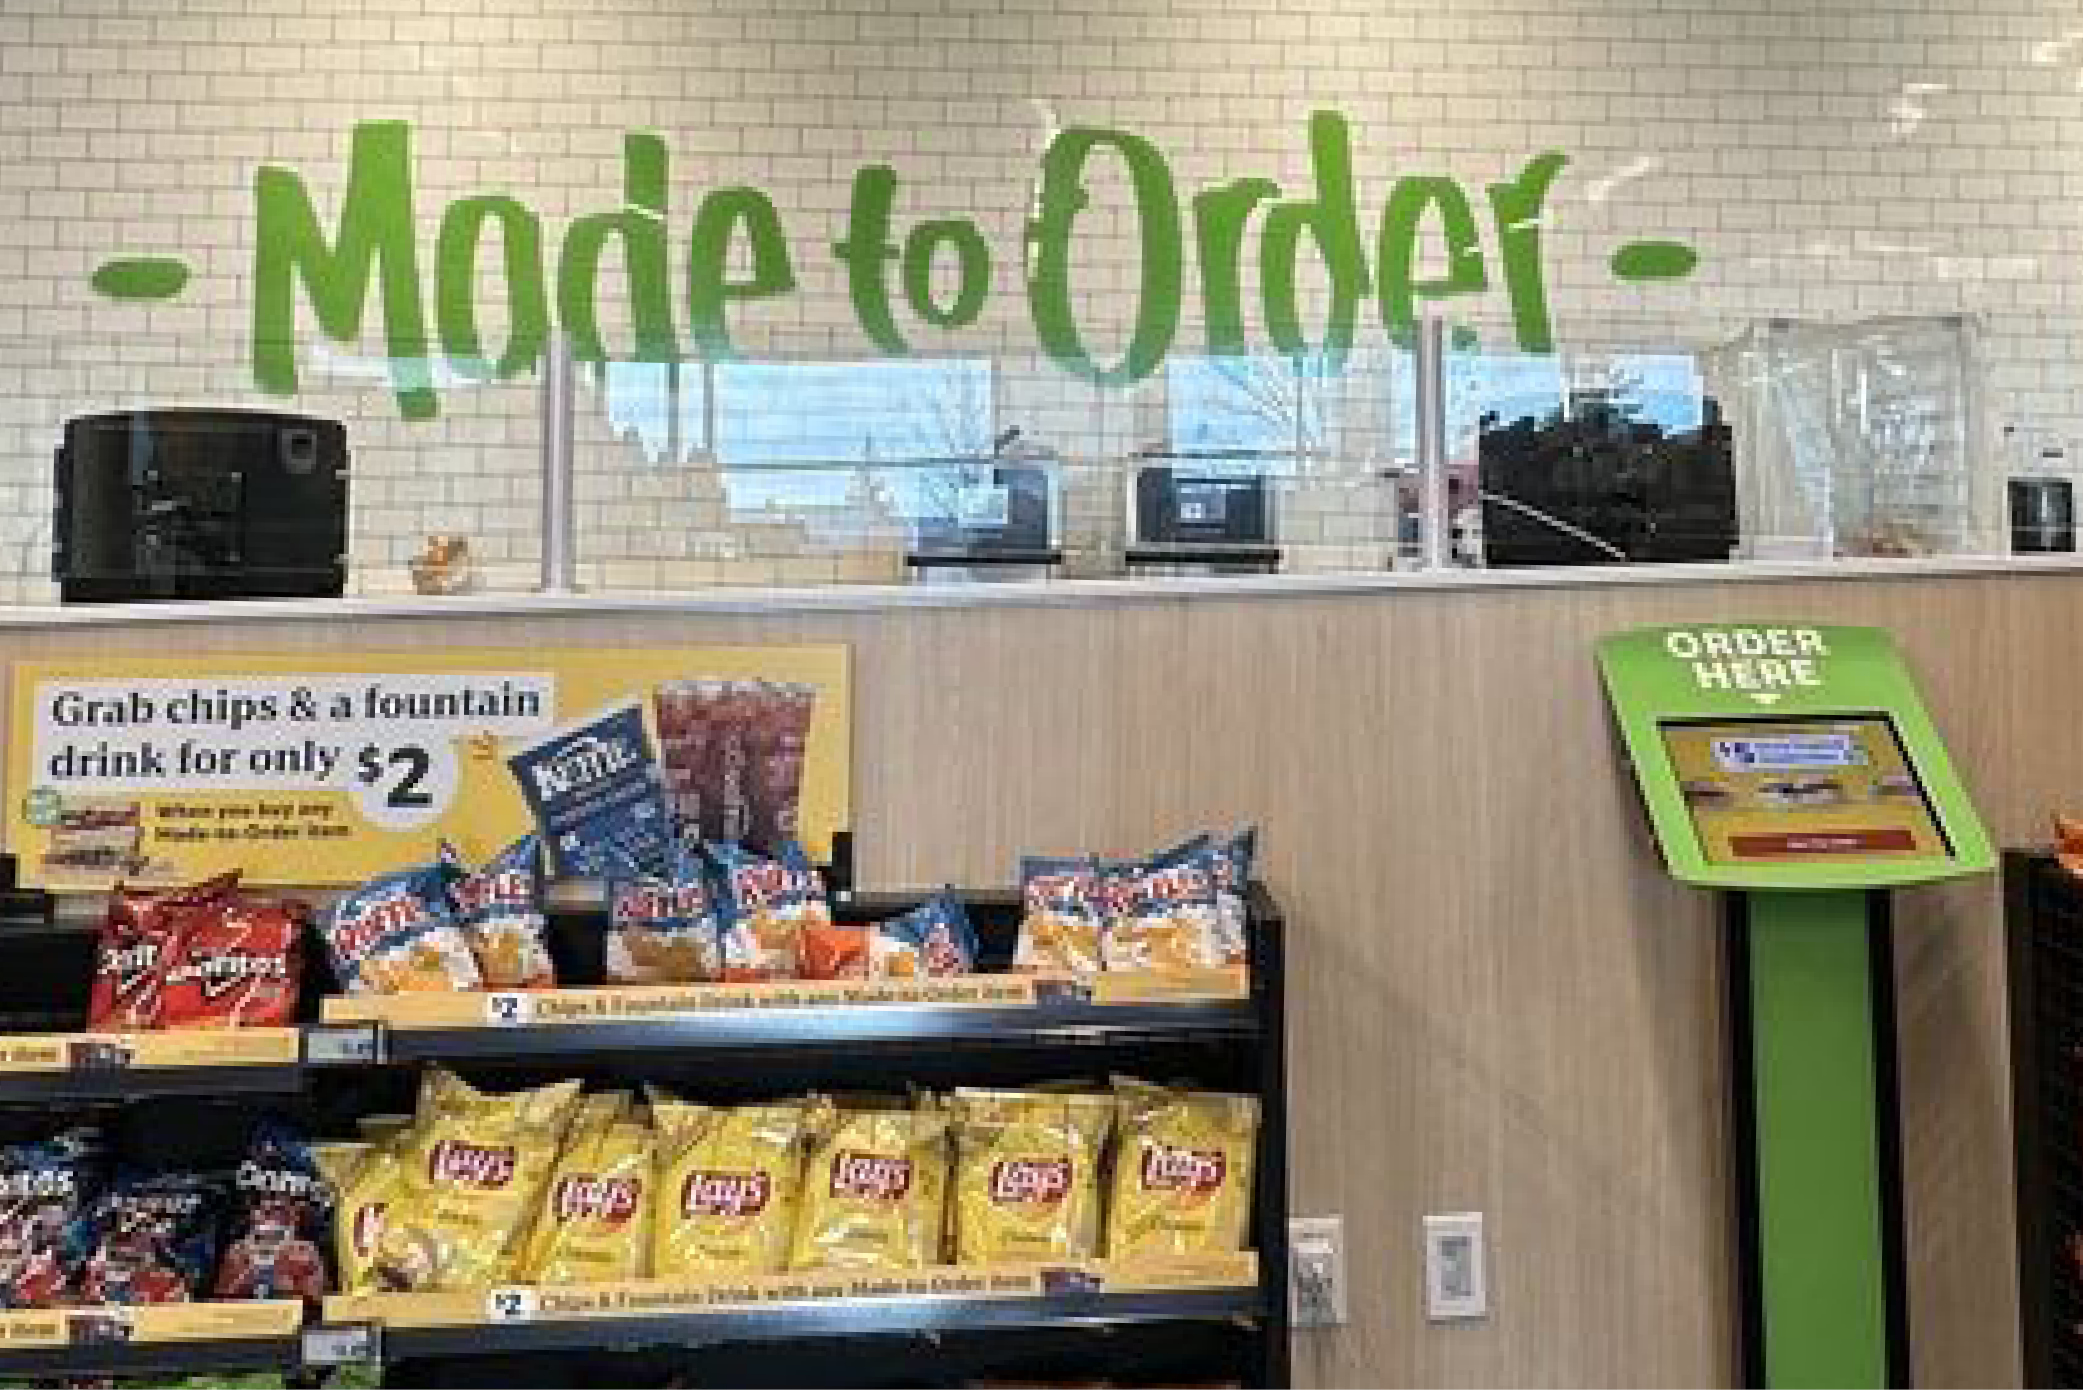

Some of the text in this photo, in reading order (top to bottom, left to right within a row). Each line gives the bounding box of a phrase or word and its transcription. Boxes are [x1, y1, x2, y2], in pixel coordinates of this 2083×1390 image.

[253, 120, 795, 419] Made
[834, 164, 990, 353] to
[1028, 109, 1568, 385] Order
[1664, 629, 1828, 658] ORDER
[1692, 659, 1822, 689] HERE
[51, 682, 541, 730] Grab chips & a fountain
[50, 740, 433, 809] drink for only $2
